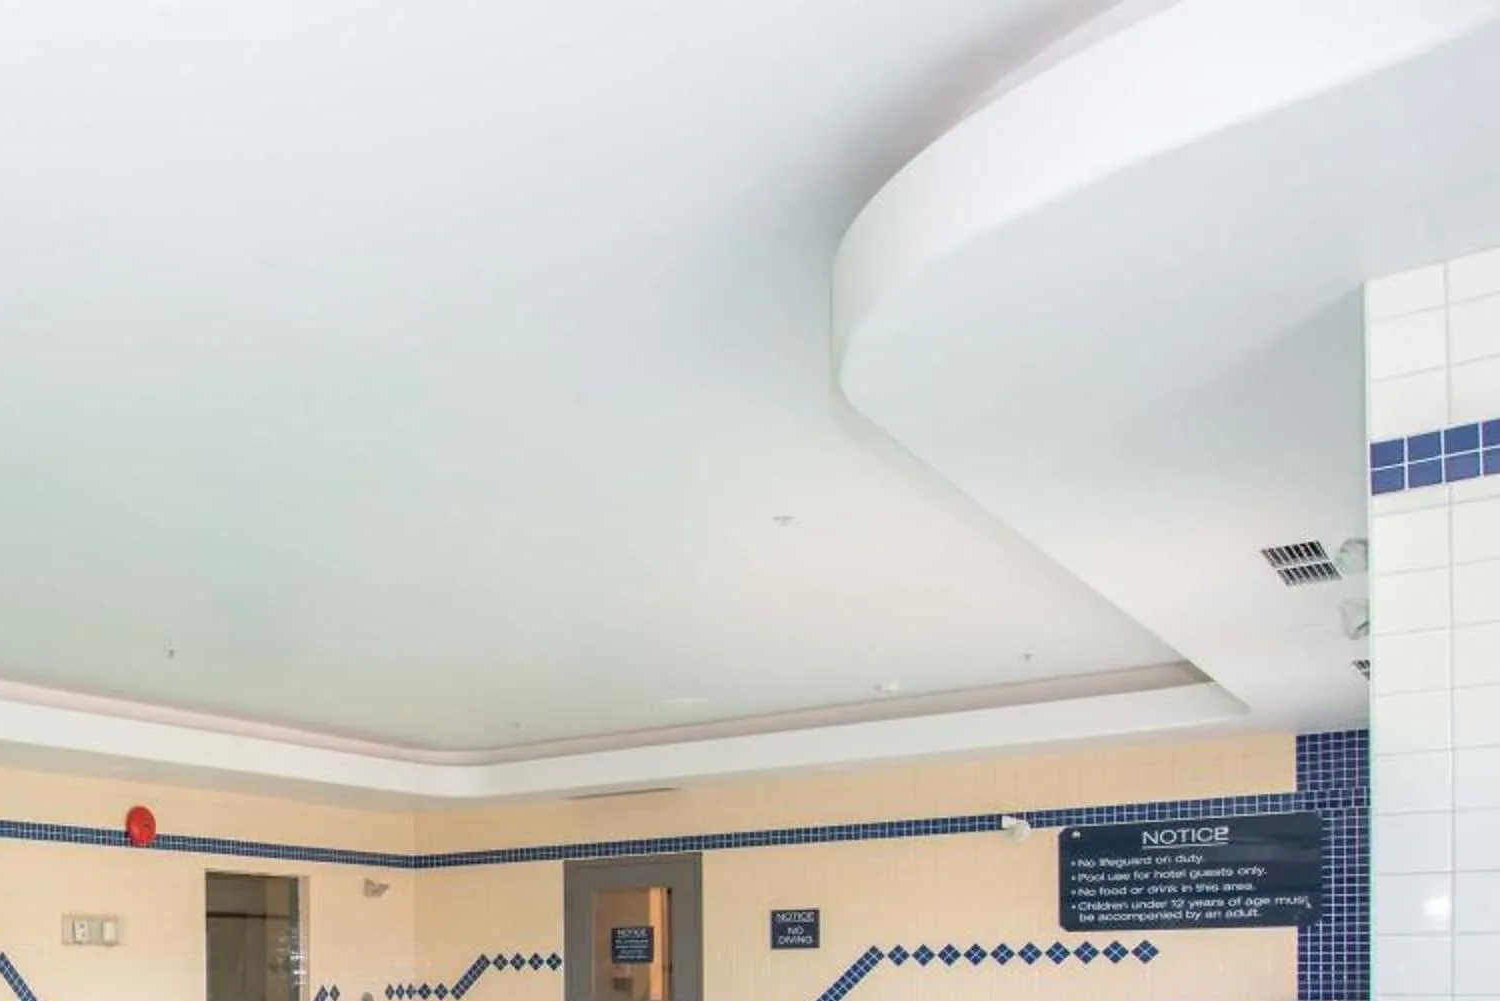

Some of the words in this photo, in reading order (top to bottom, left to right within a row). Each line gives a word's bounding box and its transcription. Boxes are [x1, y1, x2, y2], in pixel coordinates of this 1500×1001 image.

[1142, 826, 1229, 844] NOTICE
[1078, 859, 1097, 868] No
[1100, 856, 1152, 868] lifeguard
[1155, 856, 1172, 864] on
[1078, 872, 1105, 881] Pool
[1107, 873, 1131, 881] use
[1133, 870, 1150, 880] for
[1154, 869, 1187, 879] hotel
[1189, 867, 1234, 879] guests
[1237, 865, 1268, 877] only.
[1078, 887, 1097, 896] No
[1100, 886, 1127, 895] food
[1129, 886, 1143, 894] or
[1147, 884, 1178, 894] drink
[1181, 884, 1193, 892] in
[1195, 883, 1219, 893] this
[1078, 901, 1129, 911] Children
[1131, 900, 1167, 910] under
[1187, 898, 1225, 909] years
[1228, 896, 1242, 906] of
[1245, 897, 1271, 907] age
[1080, 912, 1095, 921] be
[1098, 910, 1182, 922] accompanied
[1185, 910, 1202, 920] by
[1205, 910, 1221, 919] an
